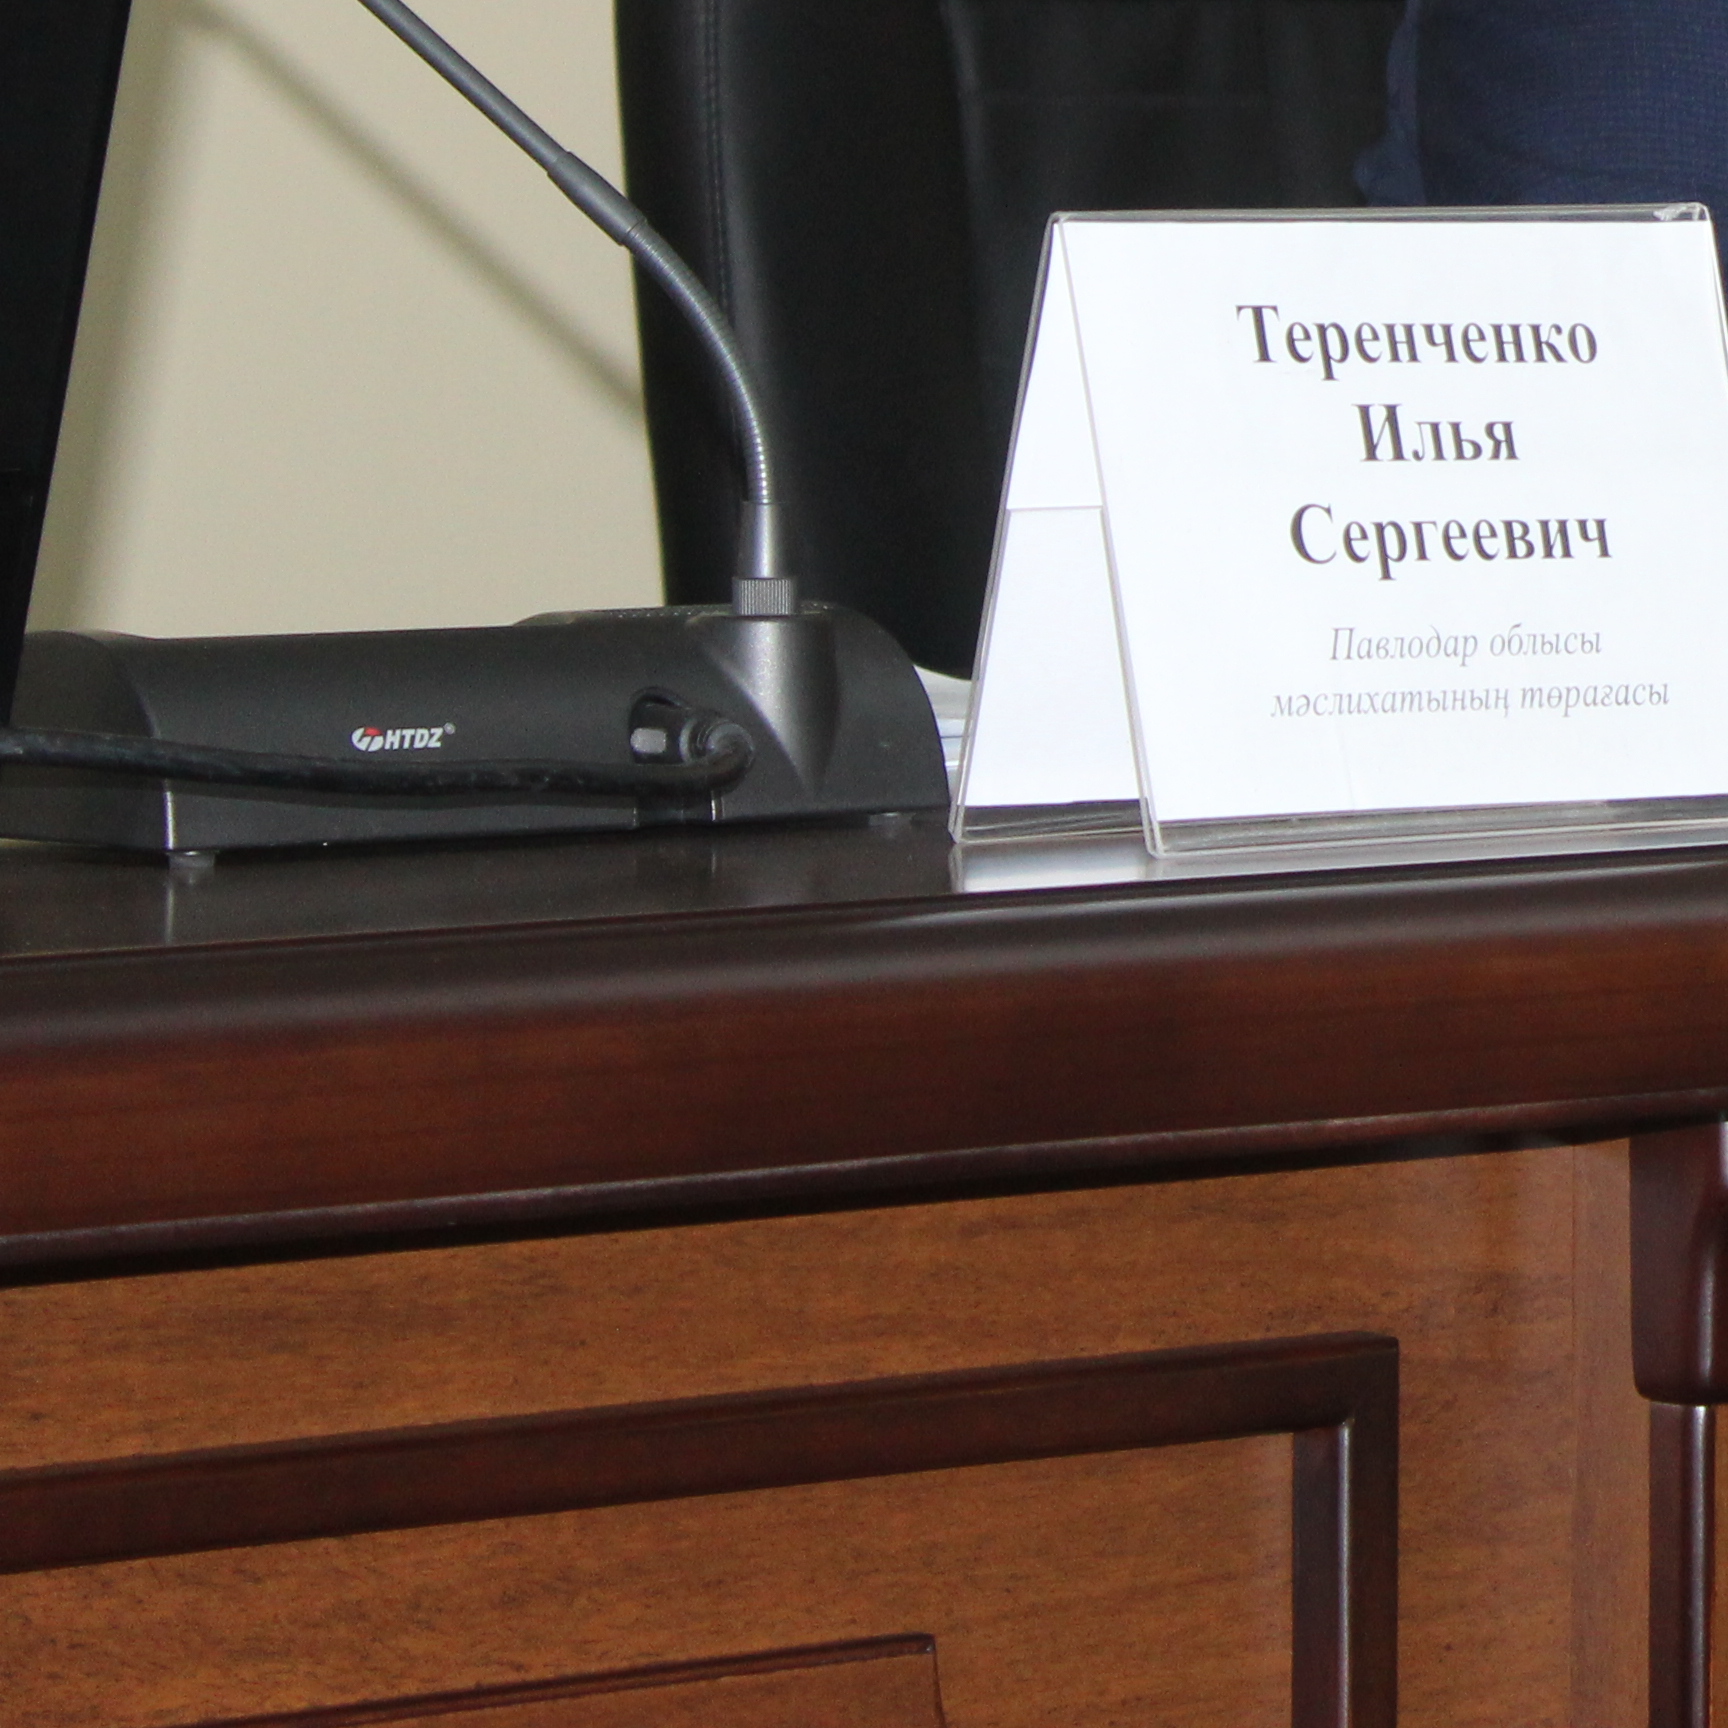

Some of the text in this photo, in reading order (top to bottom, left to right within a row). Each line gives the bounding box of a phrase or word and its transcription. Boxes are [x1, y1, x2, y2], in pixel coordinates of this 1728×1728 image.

[1235, 304, 1598, 382] Теренченко
[1354, 403, 1520, 463] Илья
[1290, 503, 1613, 581] Сергеевич
[1329, 621, 1603, 668] Павлодар облысы
[1270, 681, 1671, 719] мәслихатының төрағасы
[384, 728, 443, 750] HTDZ
